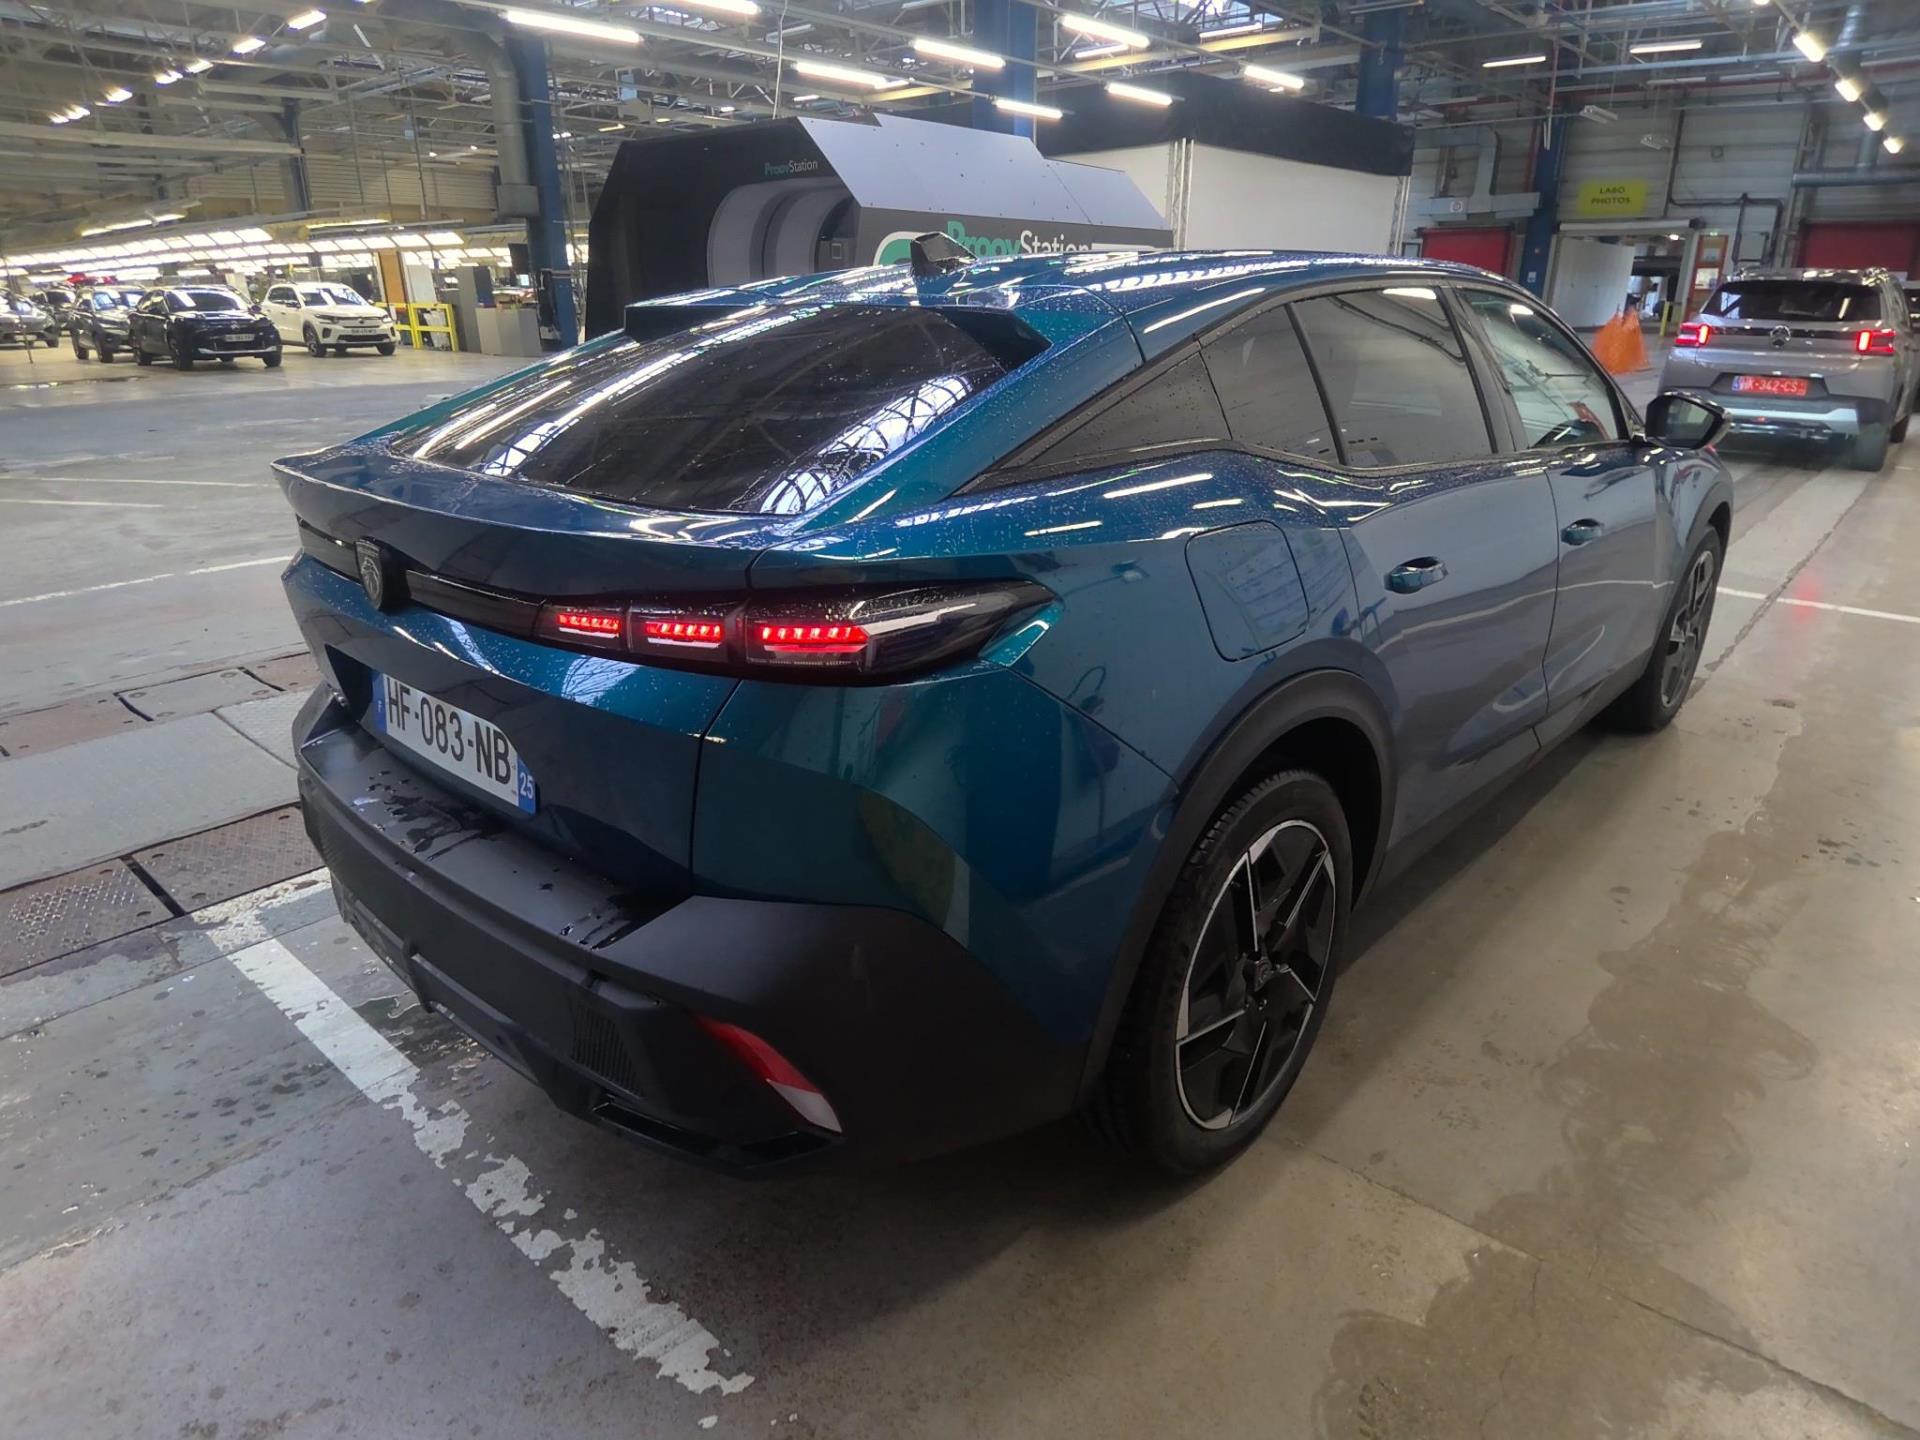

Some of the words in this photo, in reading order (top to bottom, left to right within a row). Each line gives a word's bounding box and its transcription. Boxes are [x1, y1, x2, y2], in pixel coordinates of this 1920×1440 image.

[764, 158, 818, 176] ProovStation
[386, 676, 511, 785] HF-083-NB
[519, 772, 534, 799] 25
